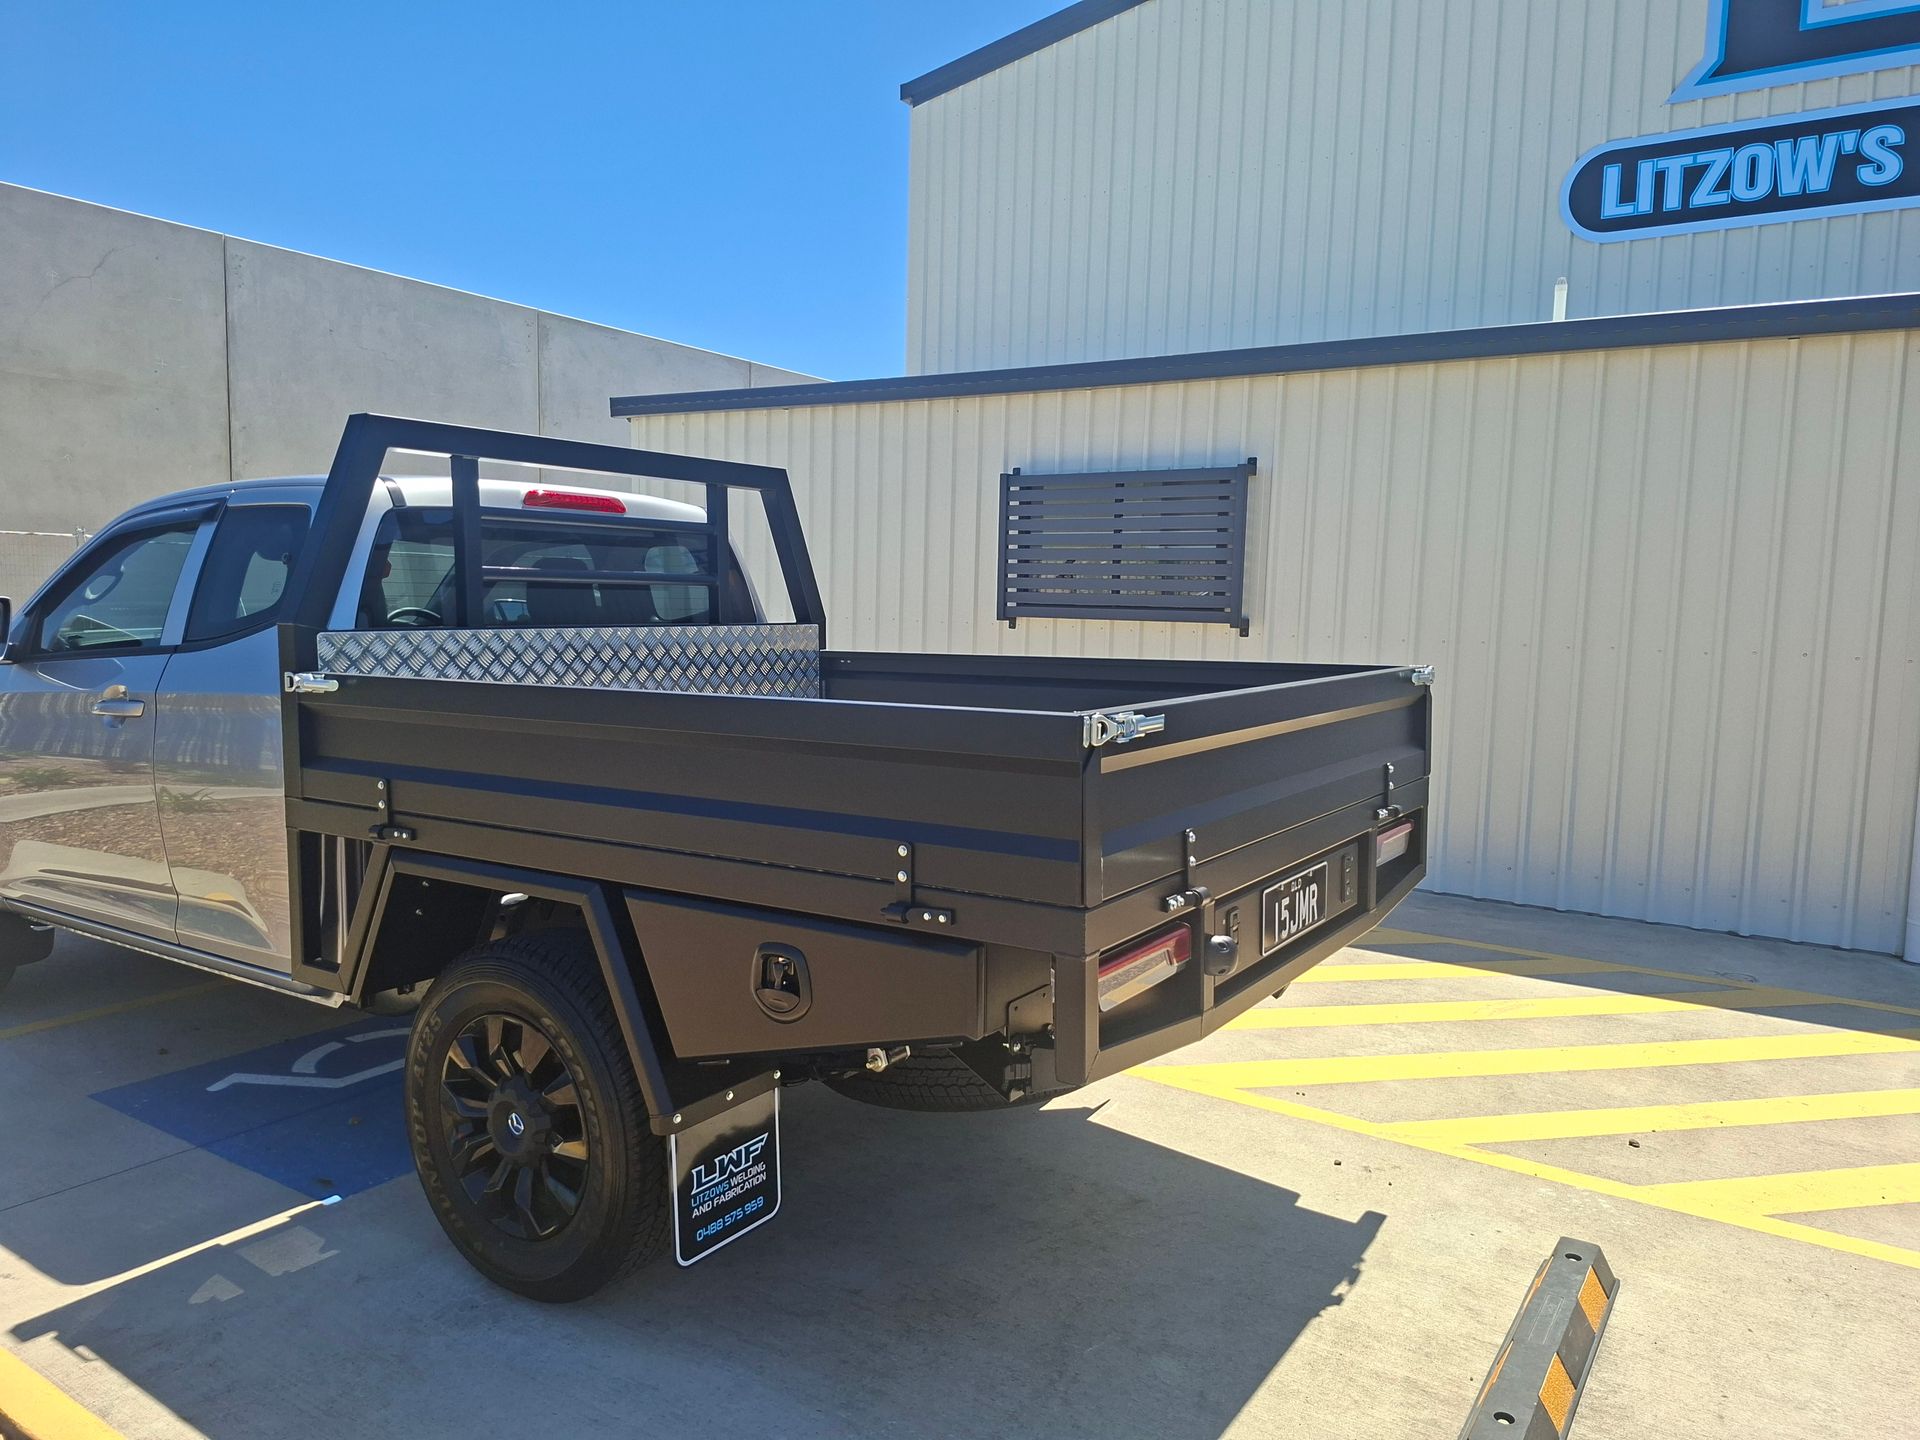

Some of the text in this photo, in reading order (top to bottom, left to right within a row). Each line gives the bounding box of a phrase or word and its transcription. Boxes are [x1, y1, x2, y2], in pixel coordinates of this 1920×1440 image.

[1601, 124, 1905, 220] LITZOW'S
[691, 1132, 769, 1195] LWF
[691, 1161, 766, 1207] LITZOWS WELDING
[692, 1172, 767, 1219] AND FABRICATION
[696, 1218, 724, 1242] 0488
[724, 1208, 744, 1227] 575
